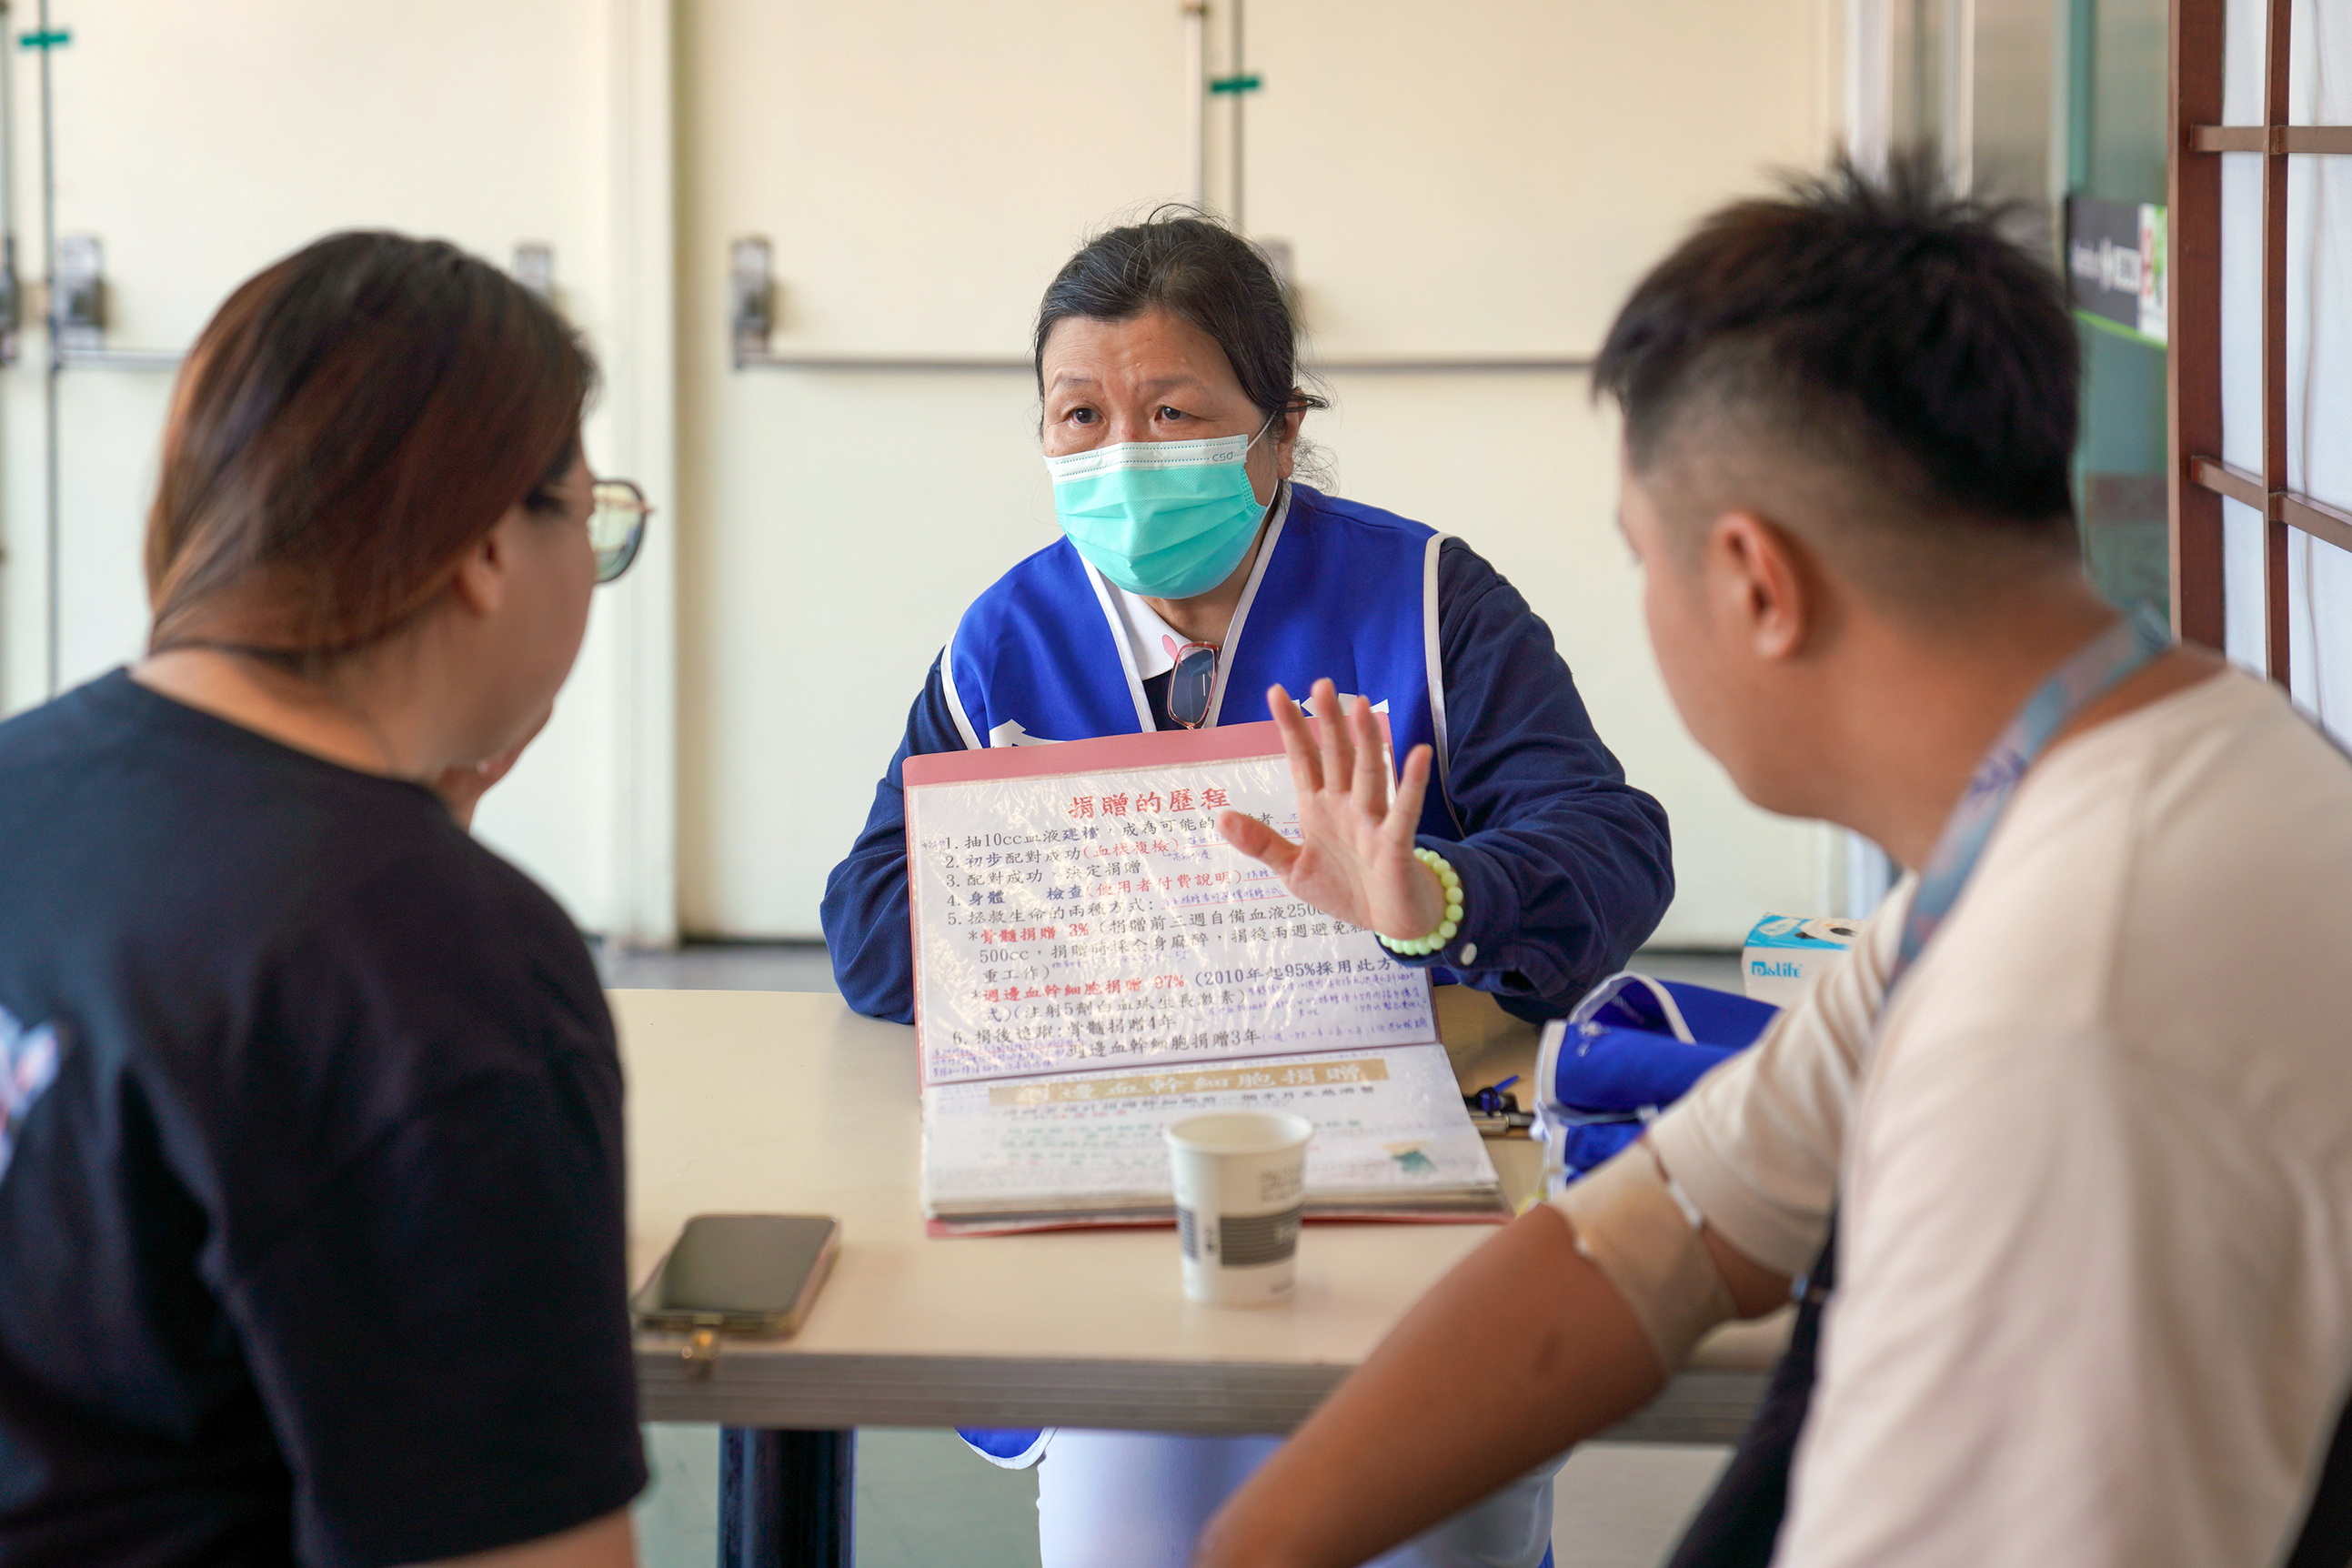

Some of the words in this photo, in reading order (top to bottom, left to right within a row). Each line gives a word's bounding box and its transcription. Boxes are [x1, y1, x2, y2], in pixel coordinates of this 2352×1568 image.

[1067, 788, 1231, 819] 捐贈的歷程
[946, 836, 959, 850] 1.
[964, 811, 1274, 850] 抽10cc血液建檔，成為可能的者
[945, 855, 960, 869] 2.
[946, 874, 960, 888] 3.
[966, 859, 1141, 887] 配對成功，決定捐贈
[946, 897, 960, 908] 4.
[968, 890, 1006, 907] 身體
[1046, 869, 1242, 901] 檢查(使用者付費說明)
[948, 912, 962, 926] 5.
[968, 897, 1153, 925] 拯救生命的兩種方式：
[1068, 922, 1090, 938] 3%
[982, 964, 1050, 984] 重工作)
[1153, 974, 1185, 990] 97%
[952, 1031, 968, 1046] 6.
